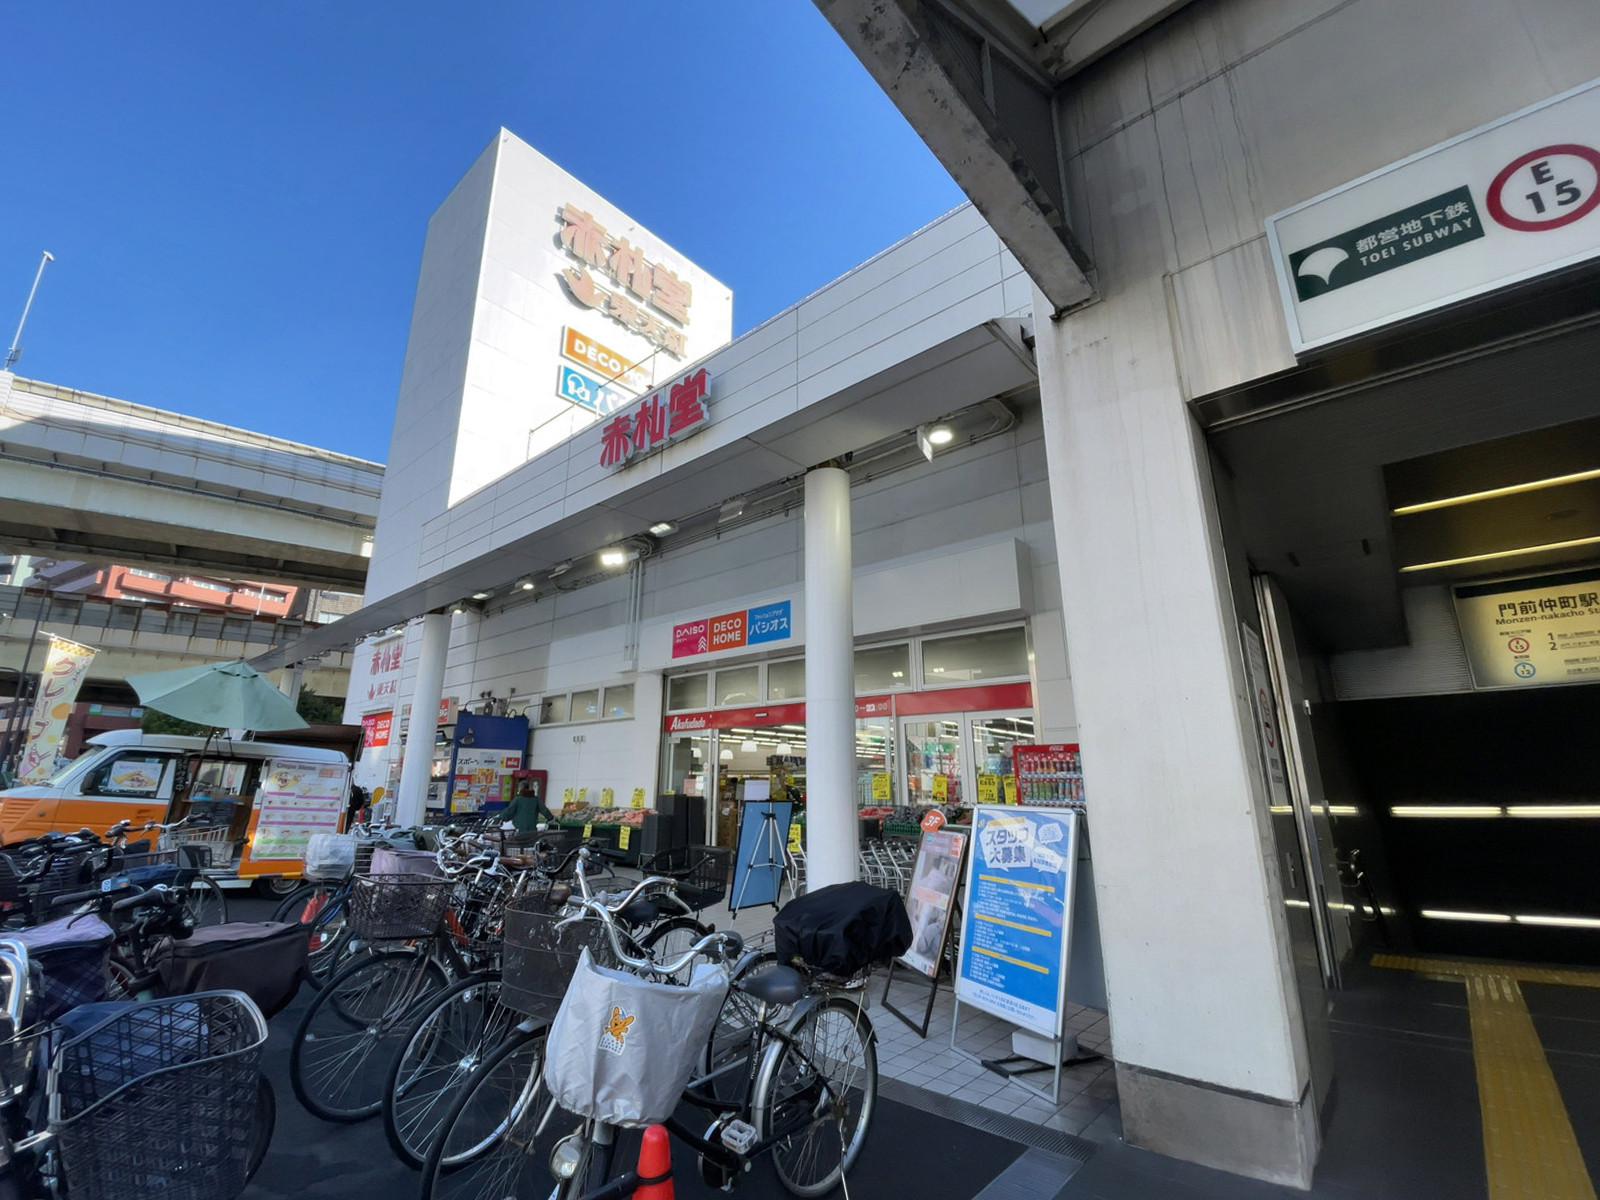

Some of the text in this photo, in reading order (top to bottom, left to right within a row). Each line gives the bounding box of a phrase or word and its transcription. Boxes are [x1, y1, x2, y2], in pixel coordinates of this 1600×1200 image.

[1530, 161, 1554, 185] E
[1525, 179, 1582, 214] 15
[1355, 200, 1470, 254] 都営地下鉄
[1360, 217, 1474, 266] TOEI SUBWAY
[560, 203, 692, 326] 赤札堂
[573, 339, 621, 374] DECO
[599, 367, 707, 468] 赤札堂
[1498, 592, 1599, 617] 門前仲町駅
[713, 618, 742, 633] DECO
[749, 617, 789, 636] パシオス
[1495, 609, 1585, 625] Monzen-nakacho
[676, 624, 705, 638] DAISO
[713, 631, 742, 645] HOME
[1549, 641, 1558, 651] 2
[370, 642, 404, 676] 赤札堂
[925, 815, 941, 826] 3F
[989, 846, 1026, 863] 大募集
